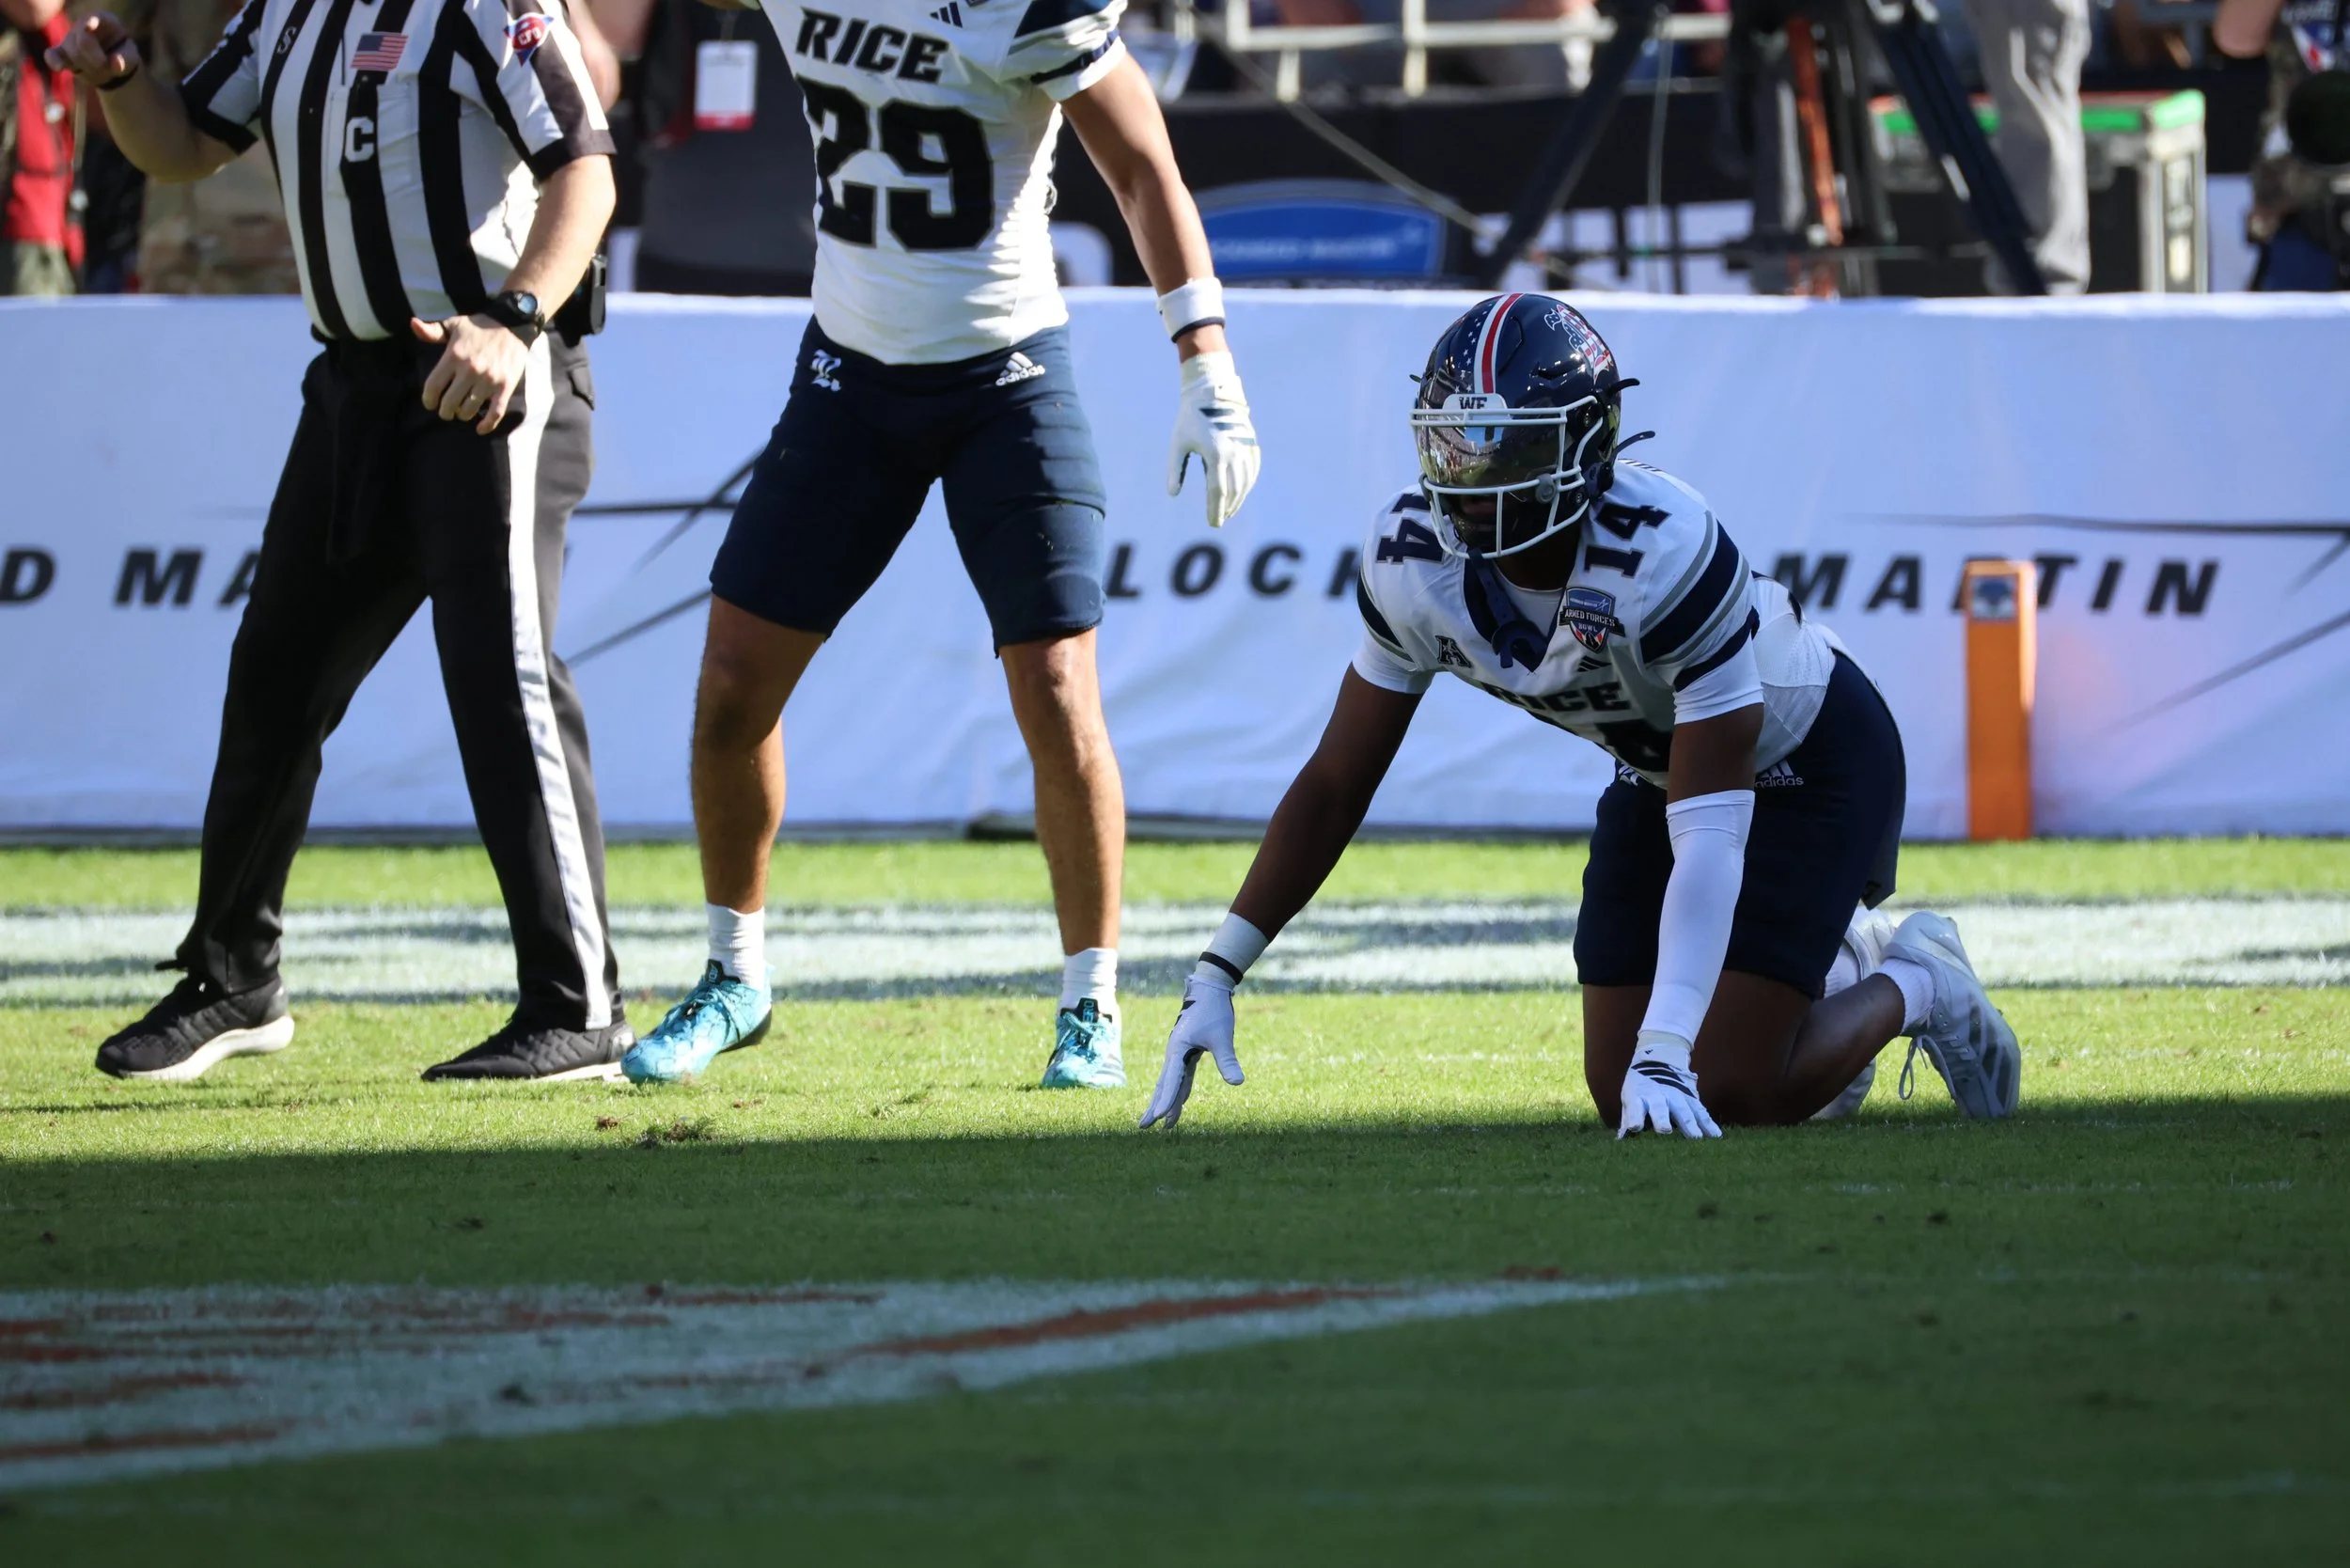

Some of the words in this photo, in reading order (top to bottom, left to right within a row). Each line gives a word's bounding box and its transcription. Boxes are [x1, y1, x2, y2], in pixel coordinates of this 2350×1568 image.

[795, 7, 949, 84] RICE
[344, 117, 374, 162] C
[795, 73, 995, 252] 29
[995, 365, 1045, 386] adidas
[1583, 501, 1672, 579] 14
[1772, 551, 2220, 617] MATIN
[1564, 608, 1585, 619] ARMED
[1586, 611, 1616, 627] FORCES
[1578, 622, 1598, 633] BOWL
[1754, 774, 1805, 789] adidas
